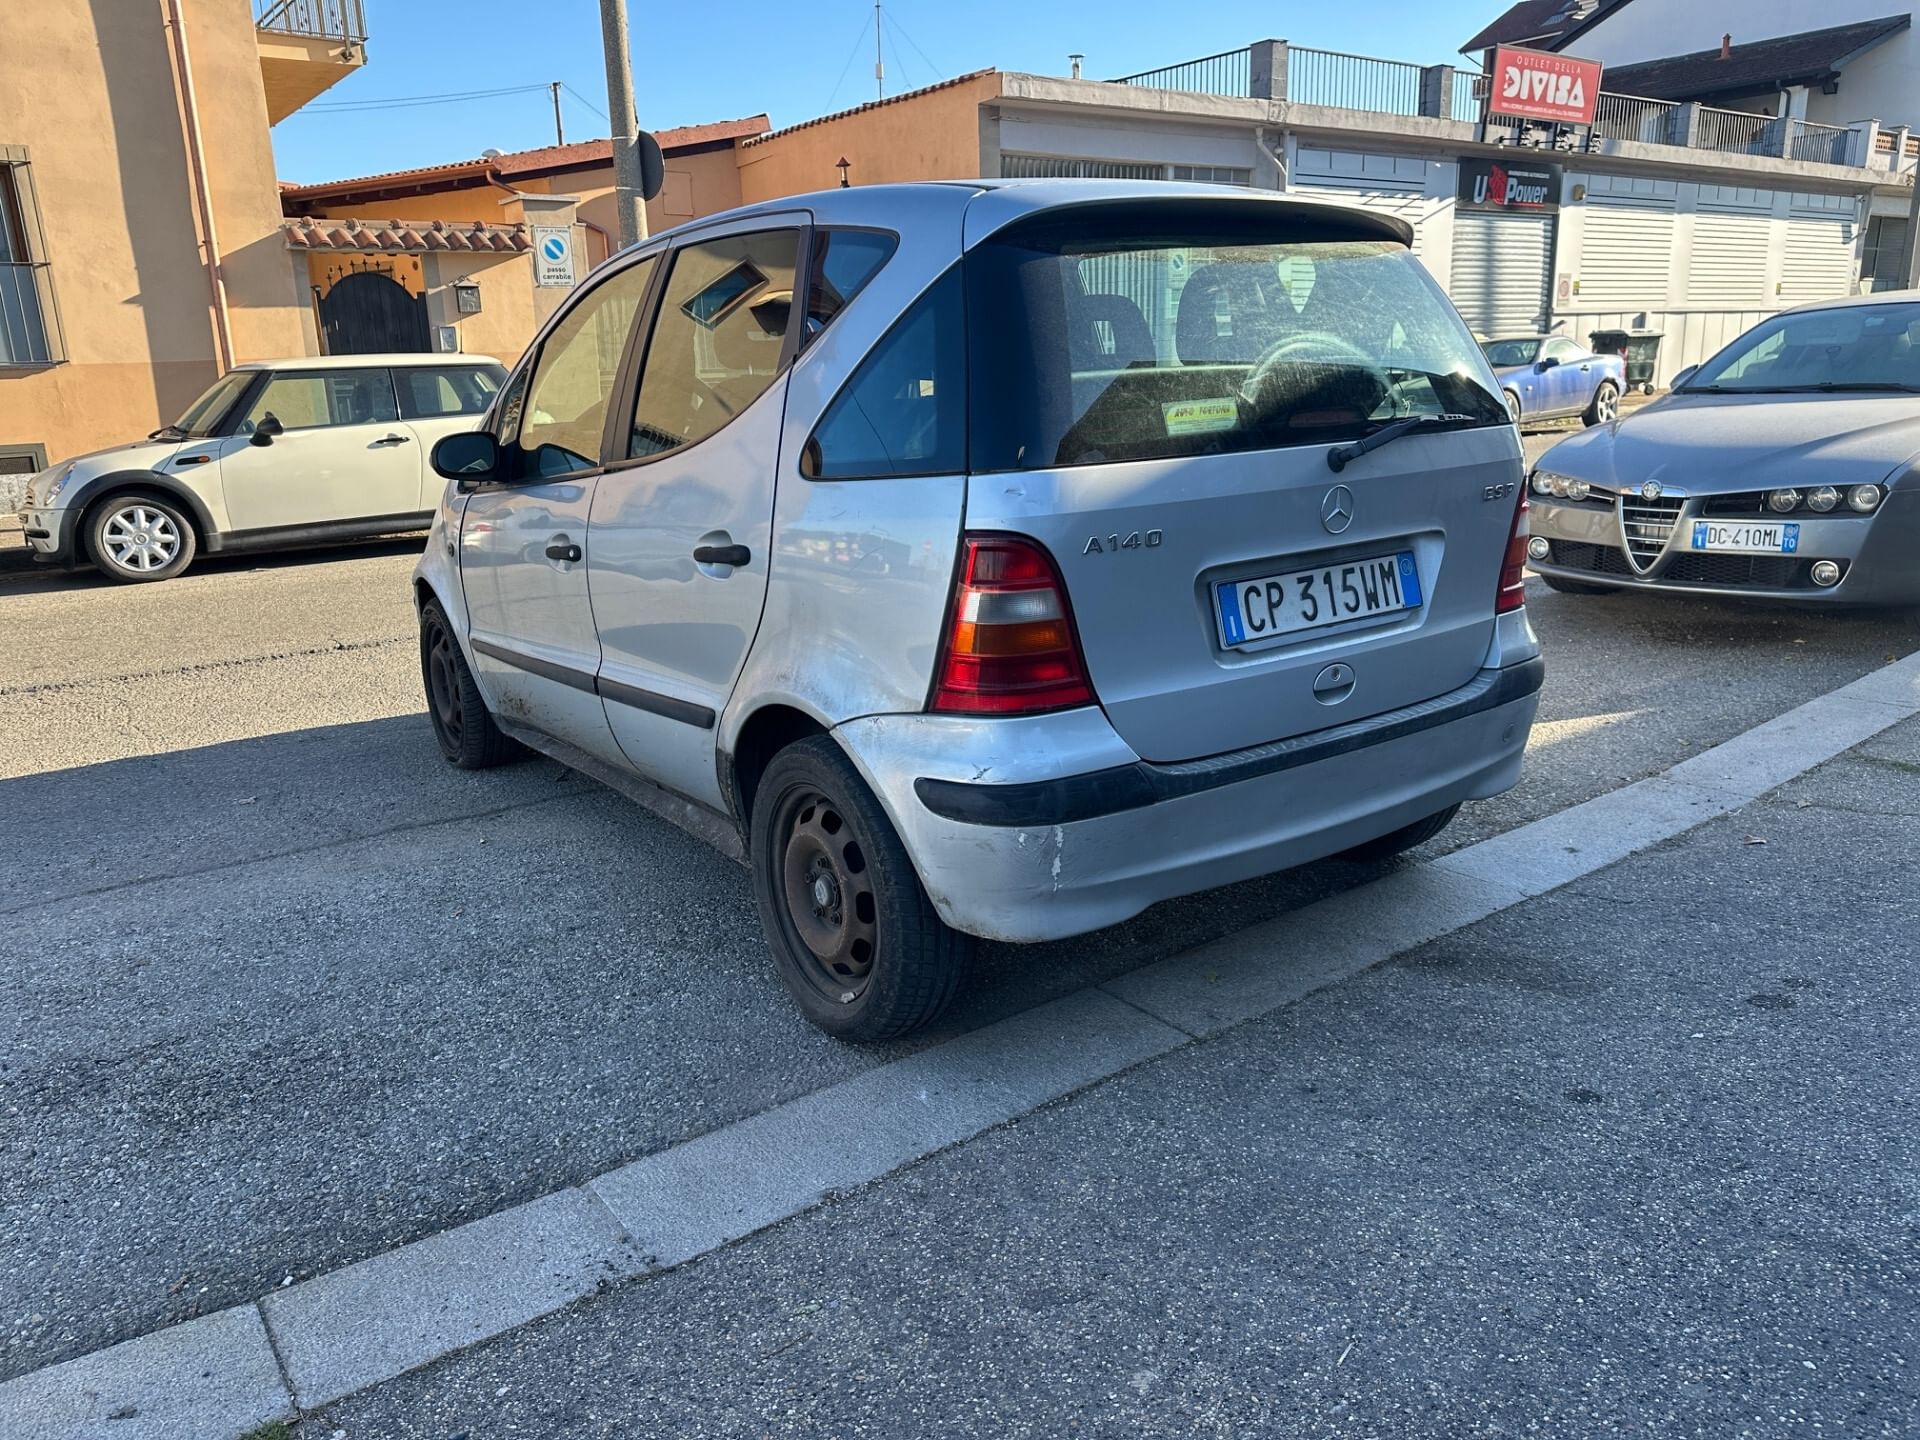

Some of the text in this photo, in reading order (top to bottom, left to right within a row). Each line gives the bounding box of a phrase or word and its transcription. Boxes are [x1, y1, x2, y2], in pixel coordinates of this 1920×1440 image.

[1517, 56, 1581, 74] OUTLET DELLA
[1503, 65, 1585, 108] DIVISA
[1504, 177, 1548, 206] Power
[1483, 482, 1514, 501] ESP
[1783, 537, 1796, 549] TO
[1243, 581, 1285, 633] CP
